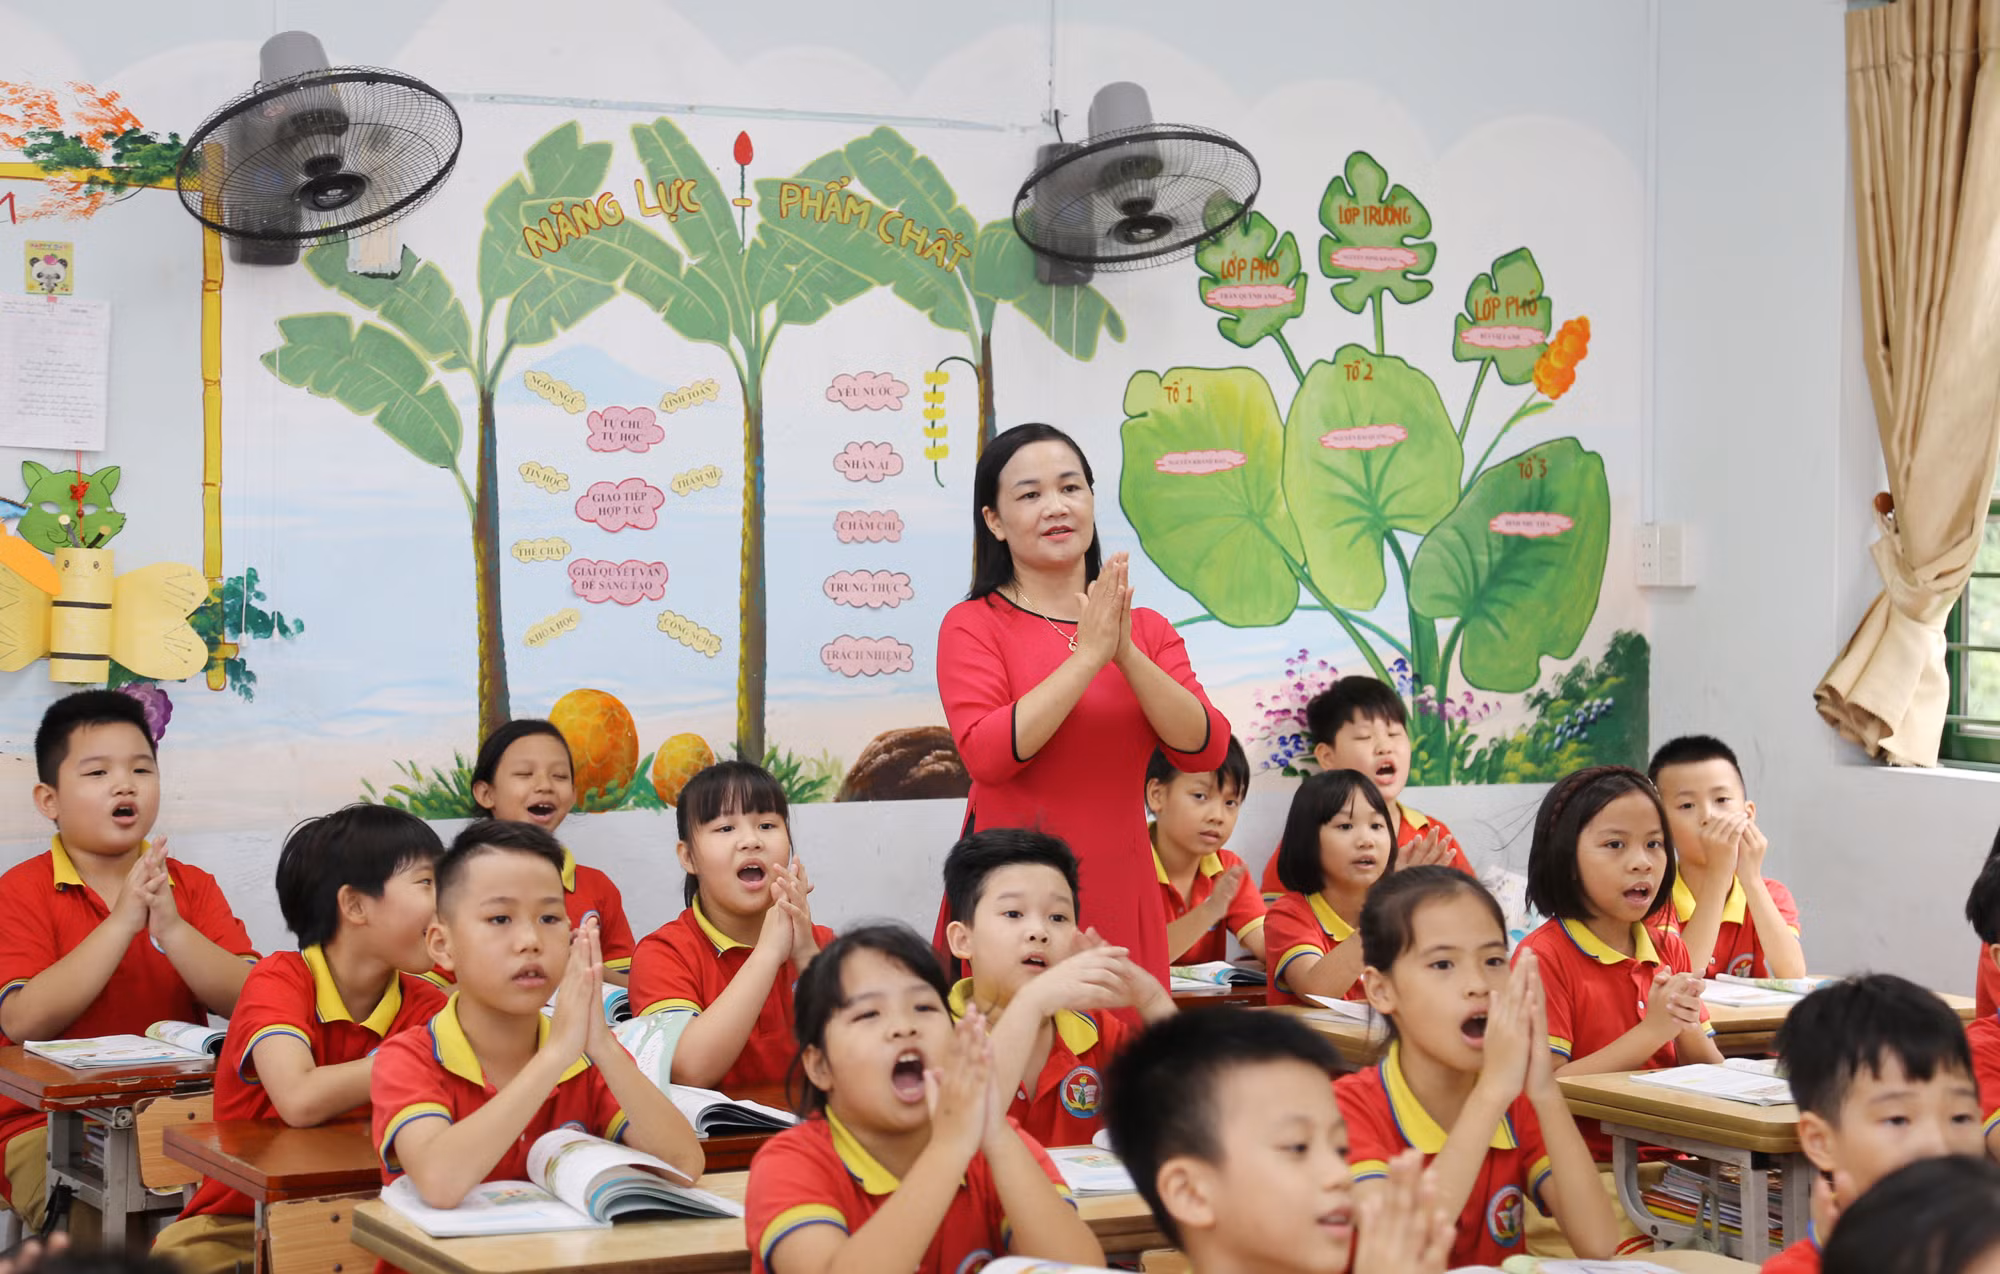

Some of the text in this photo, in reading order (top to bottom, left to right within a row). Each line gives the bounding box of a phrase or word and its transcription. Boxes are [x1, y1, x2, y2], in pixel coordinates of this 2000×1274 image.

[1338, 198, 1360, 225] LỚP
[523, 192, 625, 259] NĂNG
[635, 178, 701, 222] LỰC
[779, 176, 873, 230] PHẨM
[877, 211, 971, 273] CHẤT
[1221, 249, 1284, 281] LỚP PHÓ
[1474, 289, 1538, 321] LỚP PHÓ
[1343, 357, 1373, 381] TỔ 2
[838, 385, 859, 397] YÊU
[1163, 377, 1193, 404] TỔ 1
[620, 432, 645, 444] HỌC
[525, 466, 540, 479] TIN
[844, 457, 875, 469] NHÂN
[1538, 457, 1548, 479] 3
[592, 493, 621, 503] GIAO
[830, 582, 868, 593] TRUNG
